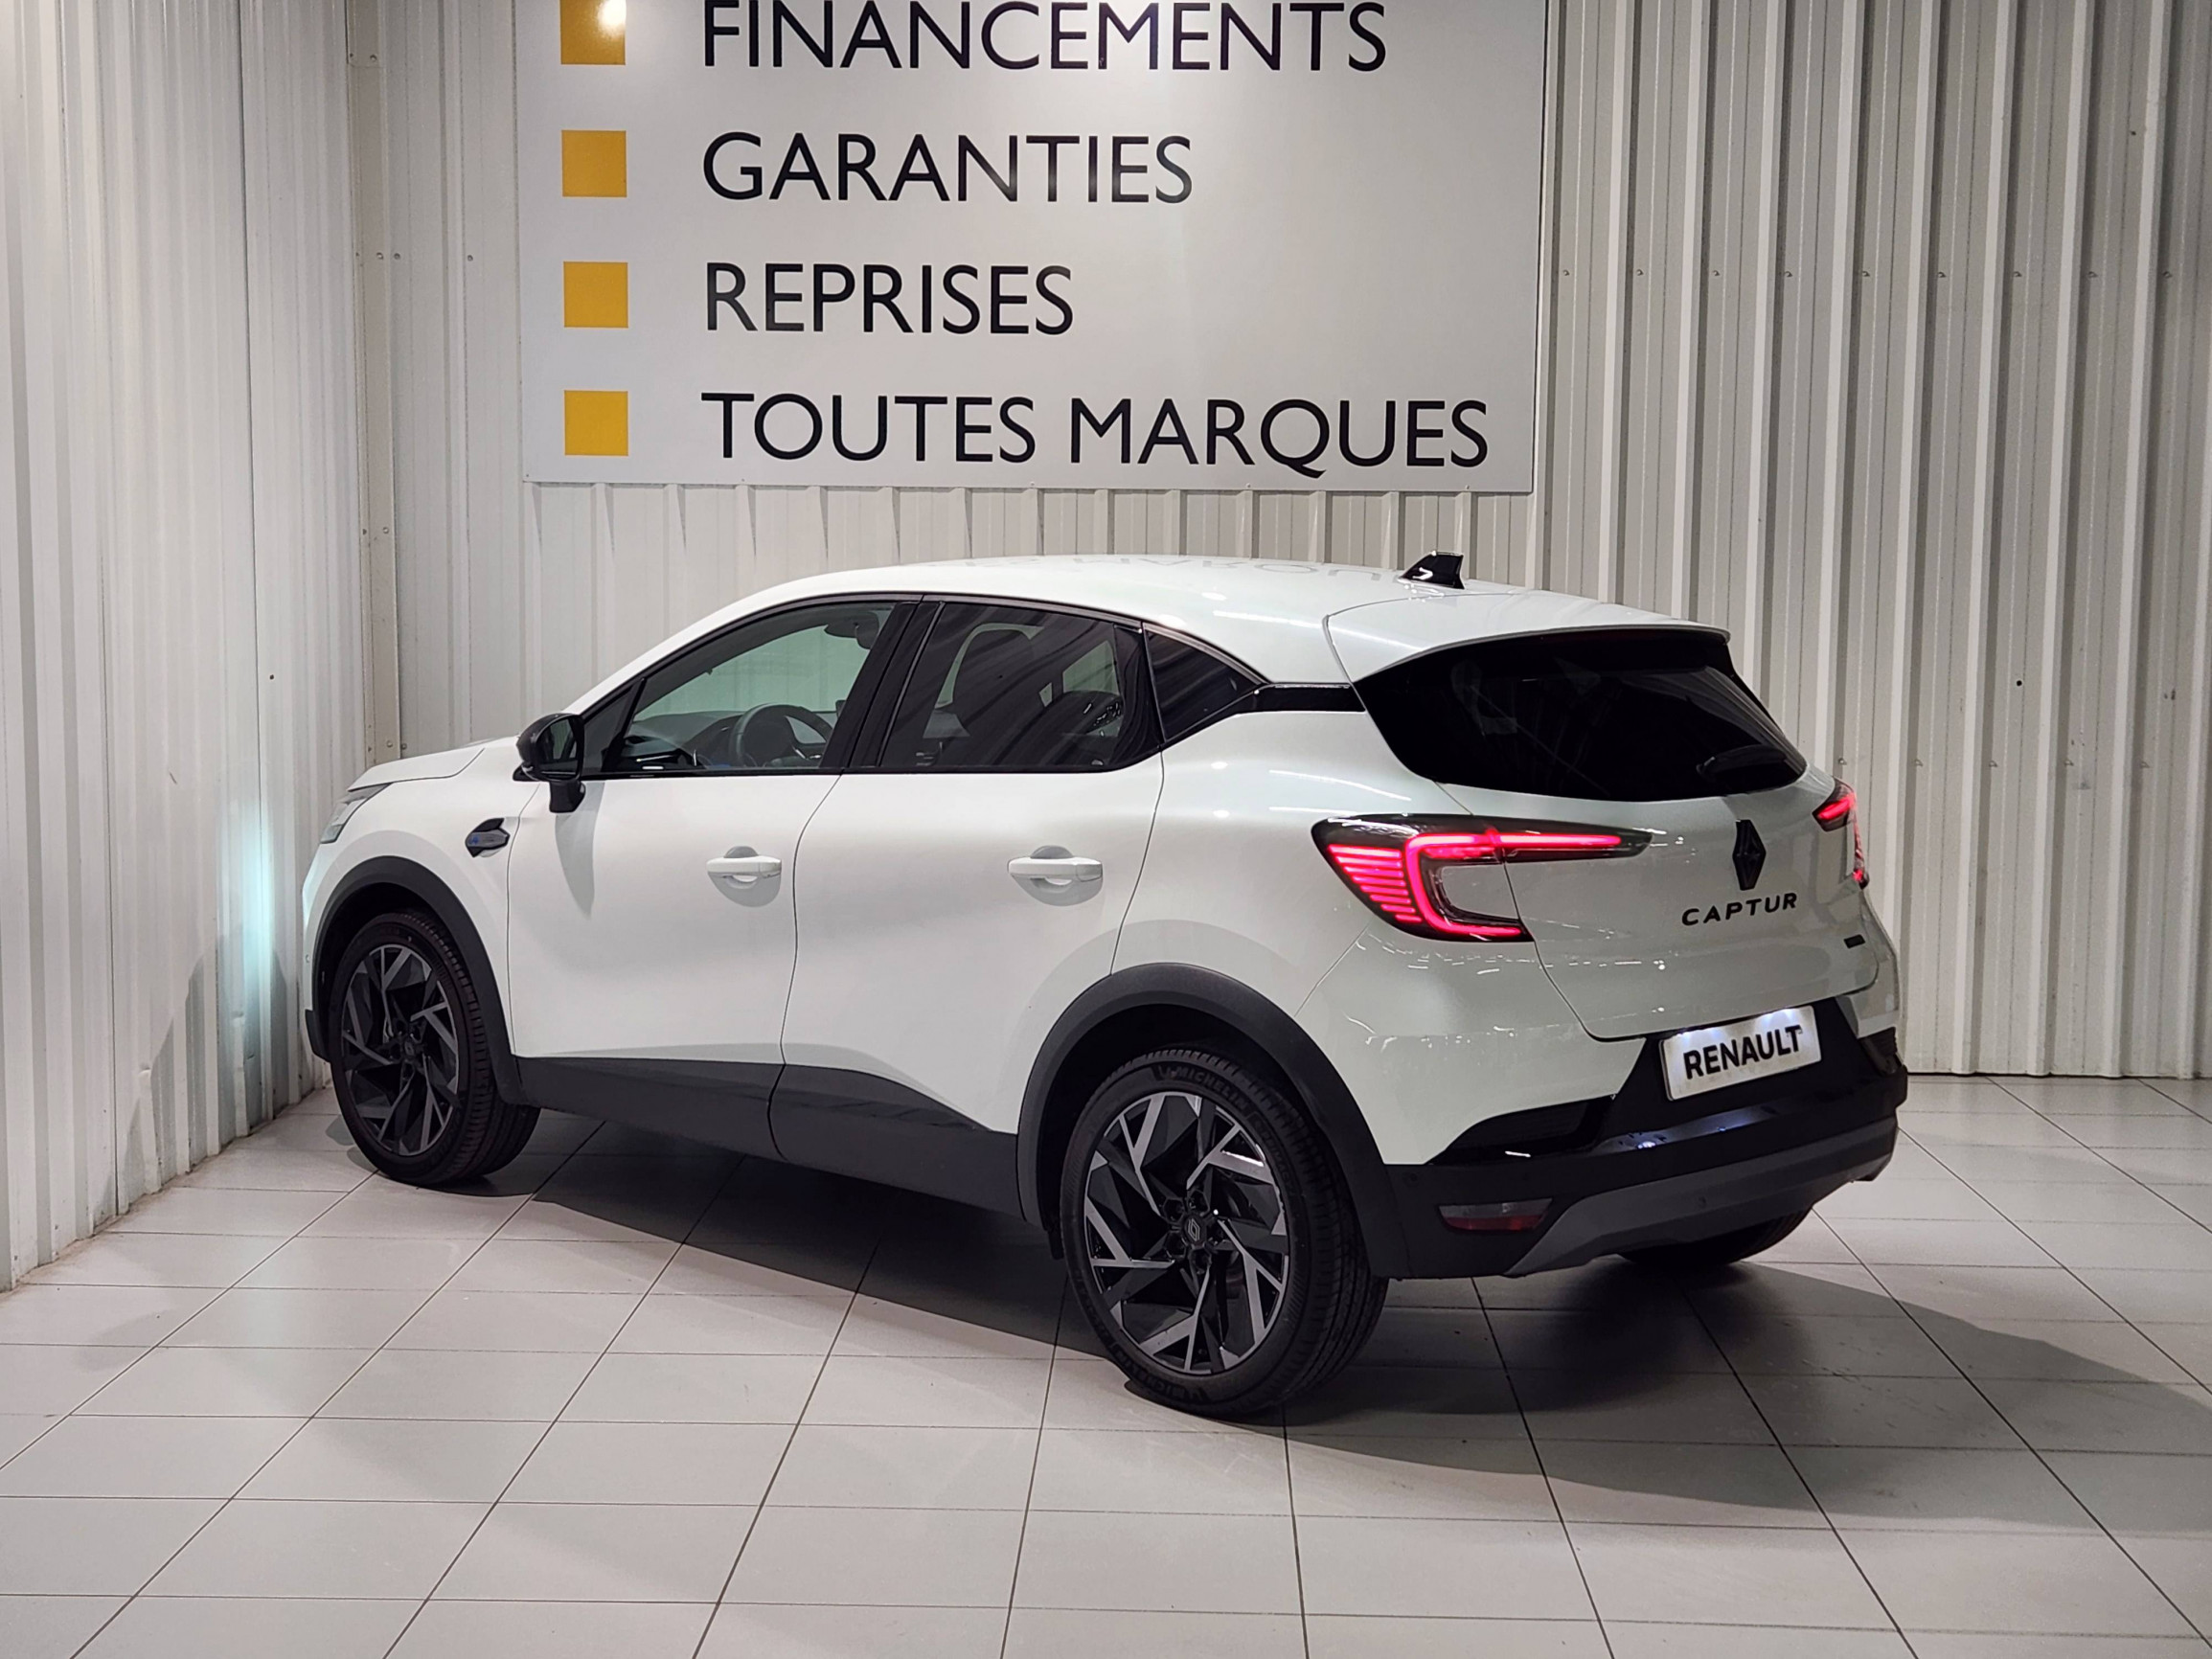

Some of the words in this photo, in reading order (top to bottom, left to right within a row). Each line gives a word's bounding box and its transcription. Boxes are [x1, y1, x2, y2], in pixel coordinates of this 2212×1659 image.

[704, 0, 1386, 72] FINANCEMENTS
[703, 131, 1192, 204] GARANTIES
[706, 261, 1073, 335] REPRISES
[700, 392, 1036, 464] TOUTES
[1070, 398, 1488, 479] MARQUES
[1681, 892, 1798, 926] CAPTUR
[1683, 1024, 1803, 1080] RENAULT
[1176, 1064, 1250, 1113] MICHELIN
